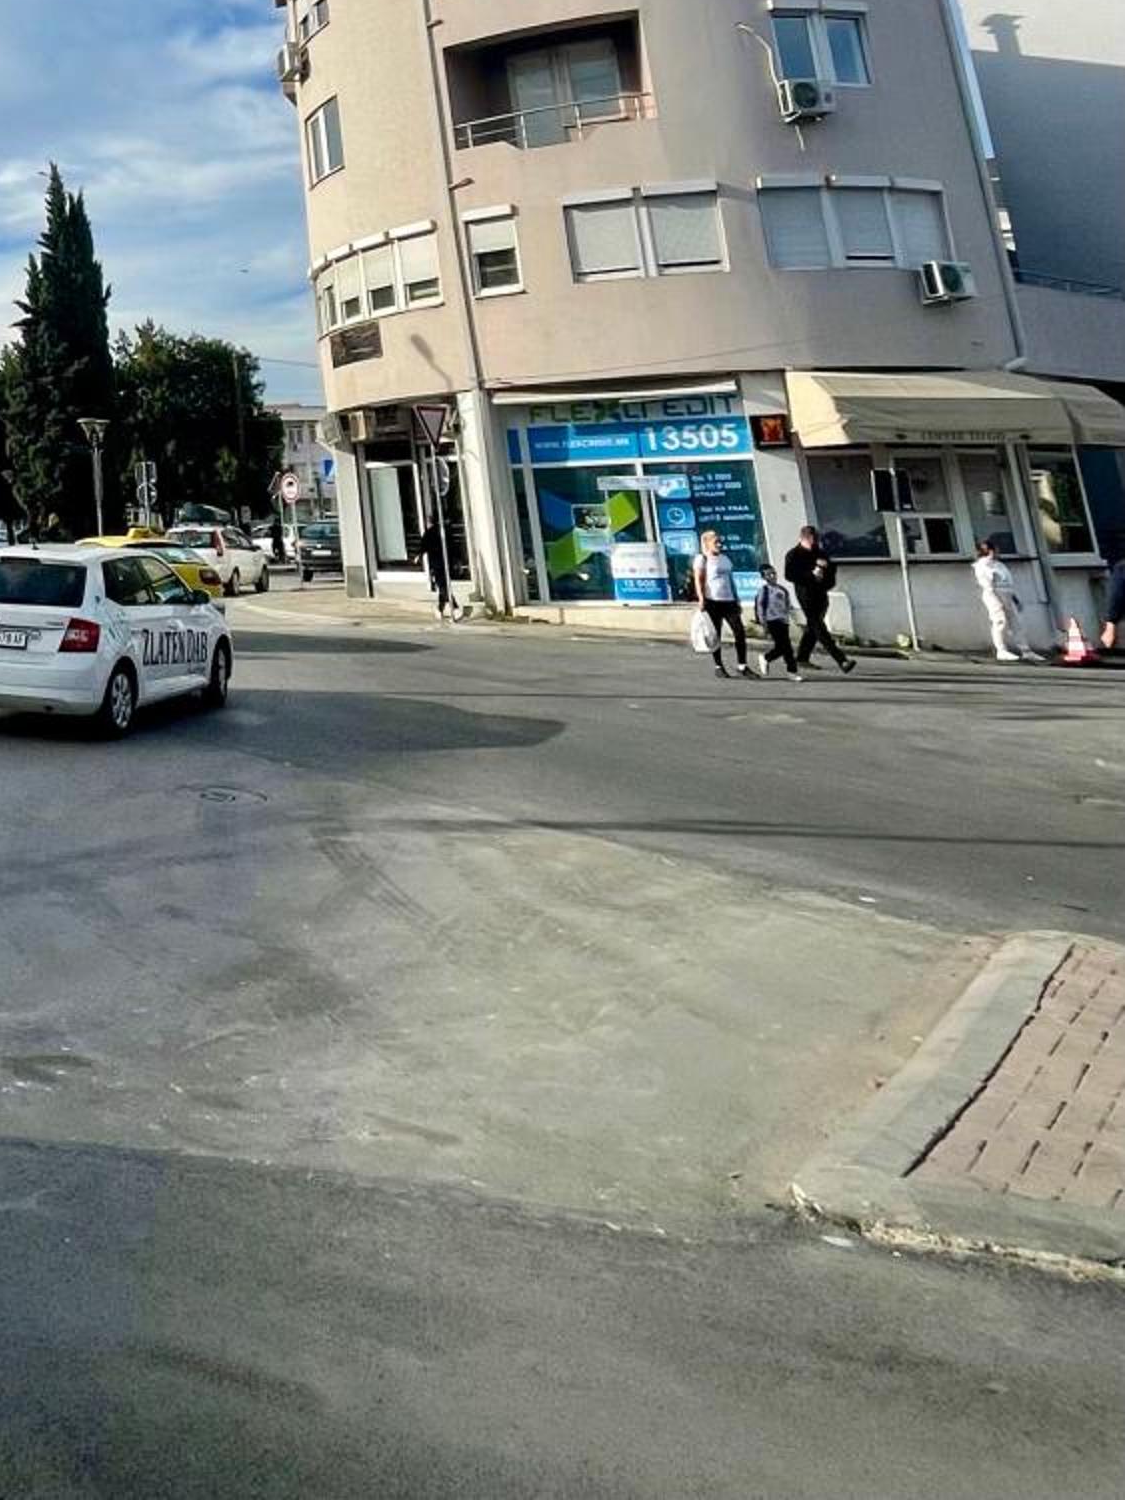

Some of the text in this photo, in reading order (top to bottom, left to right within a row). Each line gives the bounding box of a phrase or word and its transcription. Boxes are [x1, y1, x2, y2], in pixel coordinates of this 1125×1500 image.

[645, 423, 739, 451] 13505
[142, 628, 208, 666] ZLATEN DAB
